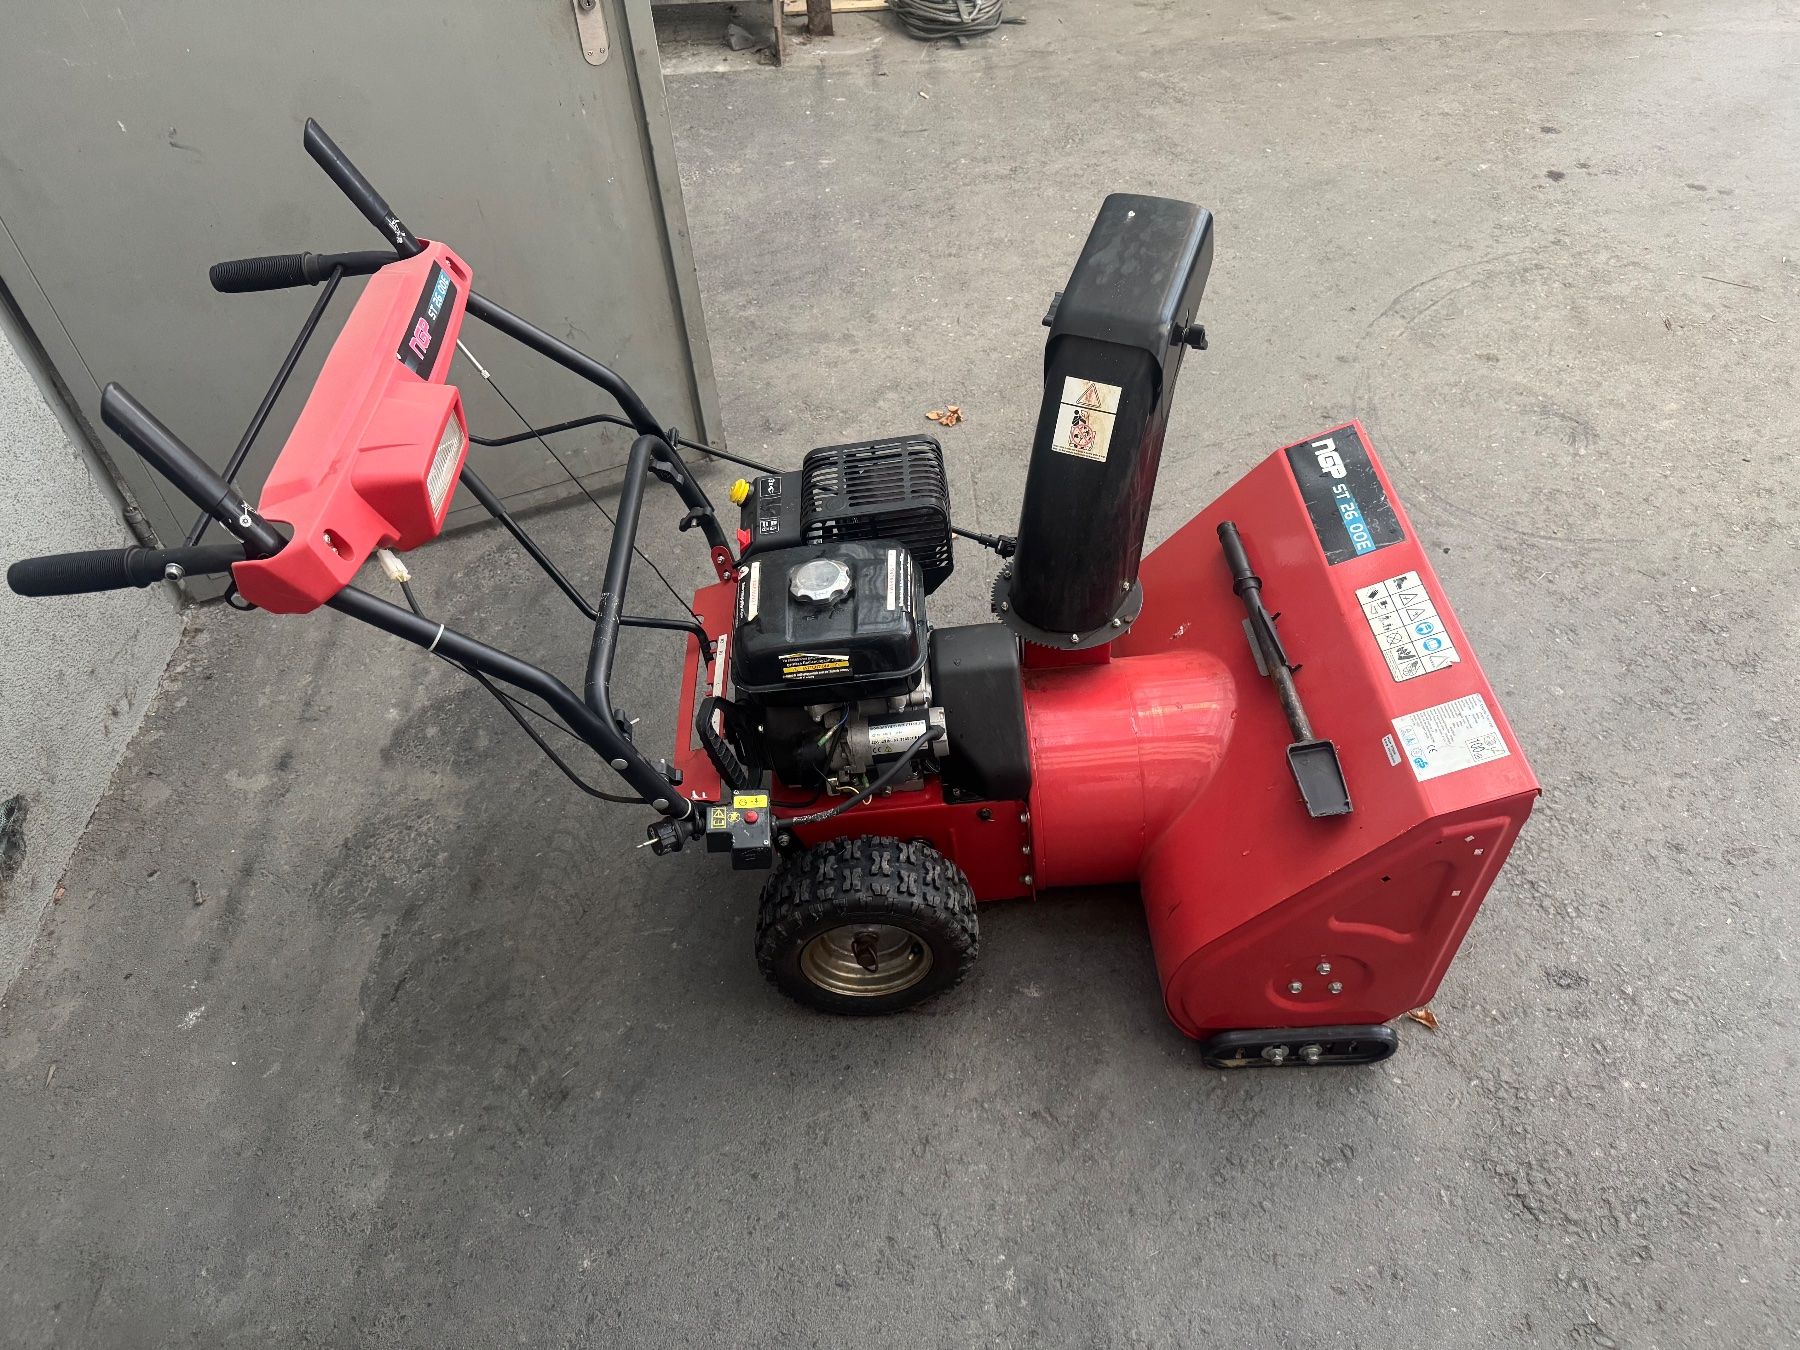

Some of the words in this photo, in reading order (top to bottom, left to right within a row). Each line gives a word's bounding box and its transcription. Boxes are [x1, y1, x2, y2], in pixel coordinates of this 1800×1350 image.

[438, 274, 450, 294] 00E
[432, 294, 443, 307] 26
[428, 304, 439, 321] ST
[1332, 483, 1350, 499] ST
[1340, 502, 1358, 520] 26
[1349, 523, 1371, 550] 00E
